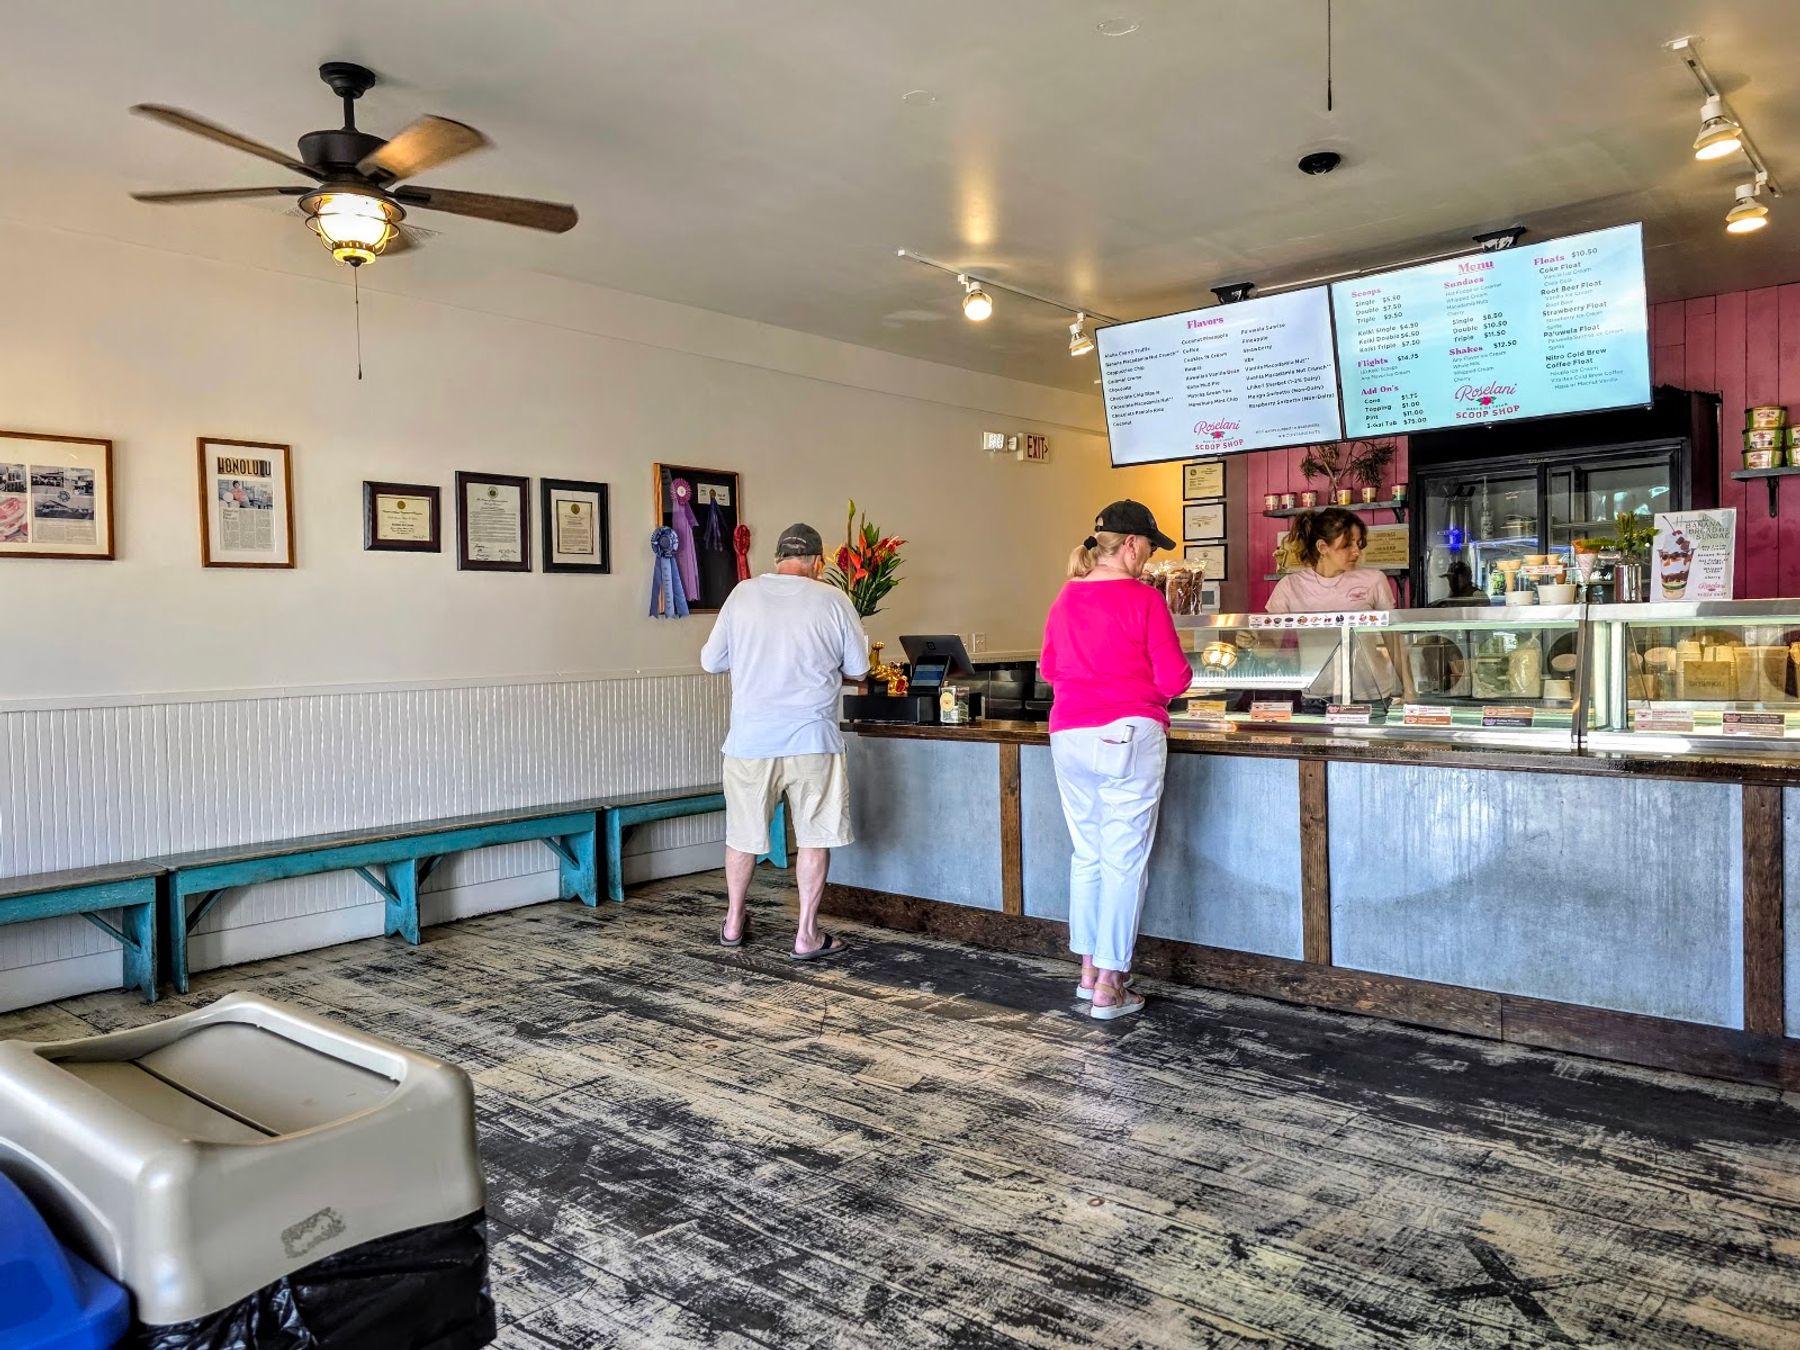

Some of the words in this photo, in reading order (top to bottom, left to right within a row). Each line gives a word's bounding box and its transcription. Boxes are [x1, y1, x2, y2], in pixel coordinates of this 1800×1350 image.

[1534, 256, 1564, 265] Floats
[1572, 248, 1597, 258] $10.50
[1459, 261, 1493, 272] Menu
[1444, 277, 1484, 289] Sundaes
[1581, 280, 1601, 288] Float
[1352, 289, 1381, 298] Scoops
[1356, 307, 1379, 316] Double
[1383, 303, 1401, 311] $7.50
[1542, 306, 1585, 317] Strawberry
[1586, 301, 1607, 309] Float
[1187, 315, 1224, 330] Flavors
[1453, 317, 1473, 325] Single
[1453, 326, 1478, 334] Double
[1484, 321, 1507, 329] $10.50
[1376, 334, 1399, 342] Double
[1484, 330, 1506, 338] $11.50
[1449, 347, 1483, 355] Shakes
[1493, 340, 1517, 348] $12.50
[1358, 358, 1388, 367] Flights
[1362, 387, 1377, 395] Add
[1455, 381, 1517, 402] Roselani
[1492, 405, 1520, 416] SHOP
[1194, 418, 1240, 436] Roselani
[1027, 435, 1045, 459] EXIT
[1195, 442, 1220, 450] SCOOP
[1223, 439, 1244, 448] SHOP
[217, 457, 271, 476] HONOLULU
[1685, 519, 1722, 529] BANANA
